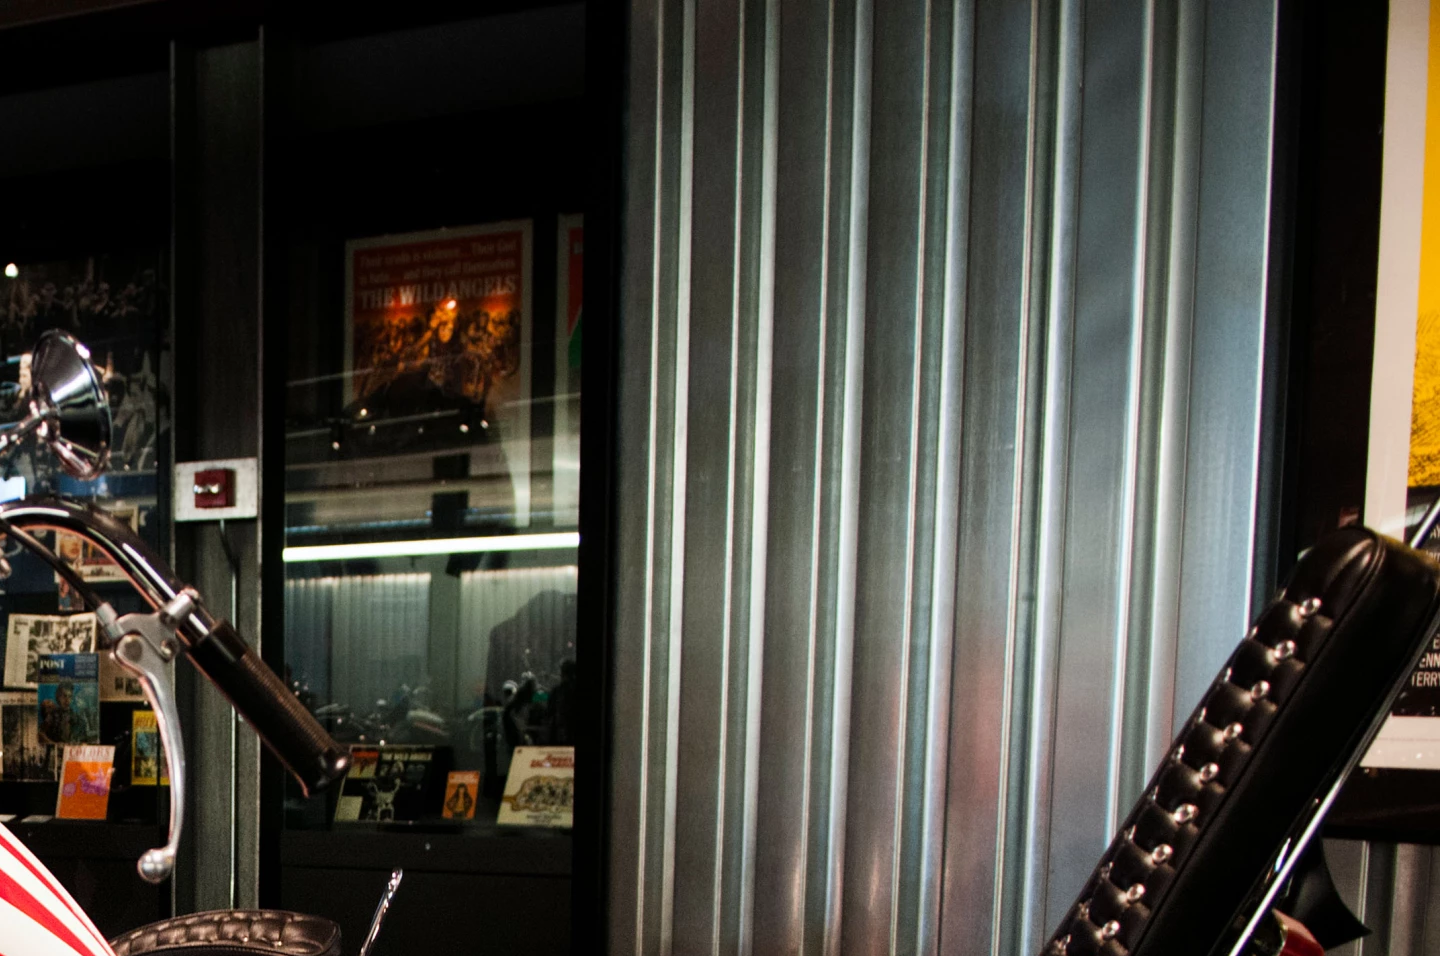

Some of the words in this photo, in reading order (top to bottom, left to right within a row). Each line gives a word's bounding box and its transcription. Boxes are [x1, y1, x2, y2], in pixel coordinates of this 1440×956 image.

[360, 286, 396, 310] THE
[398, 280, 445, 307] WILD
[446, 273, 518, 302] ANGELS
[39, 659, 65, 669] POST
